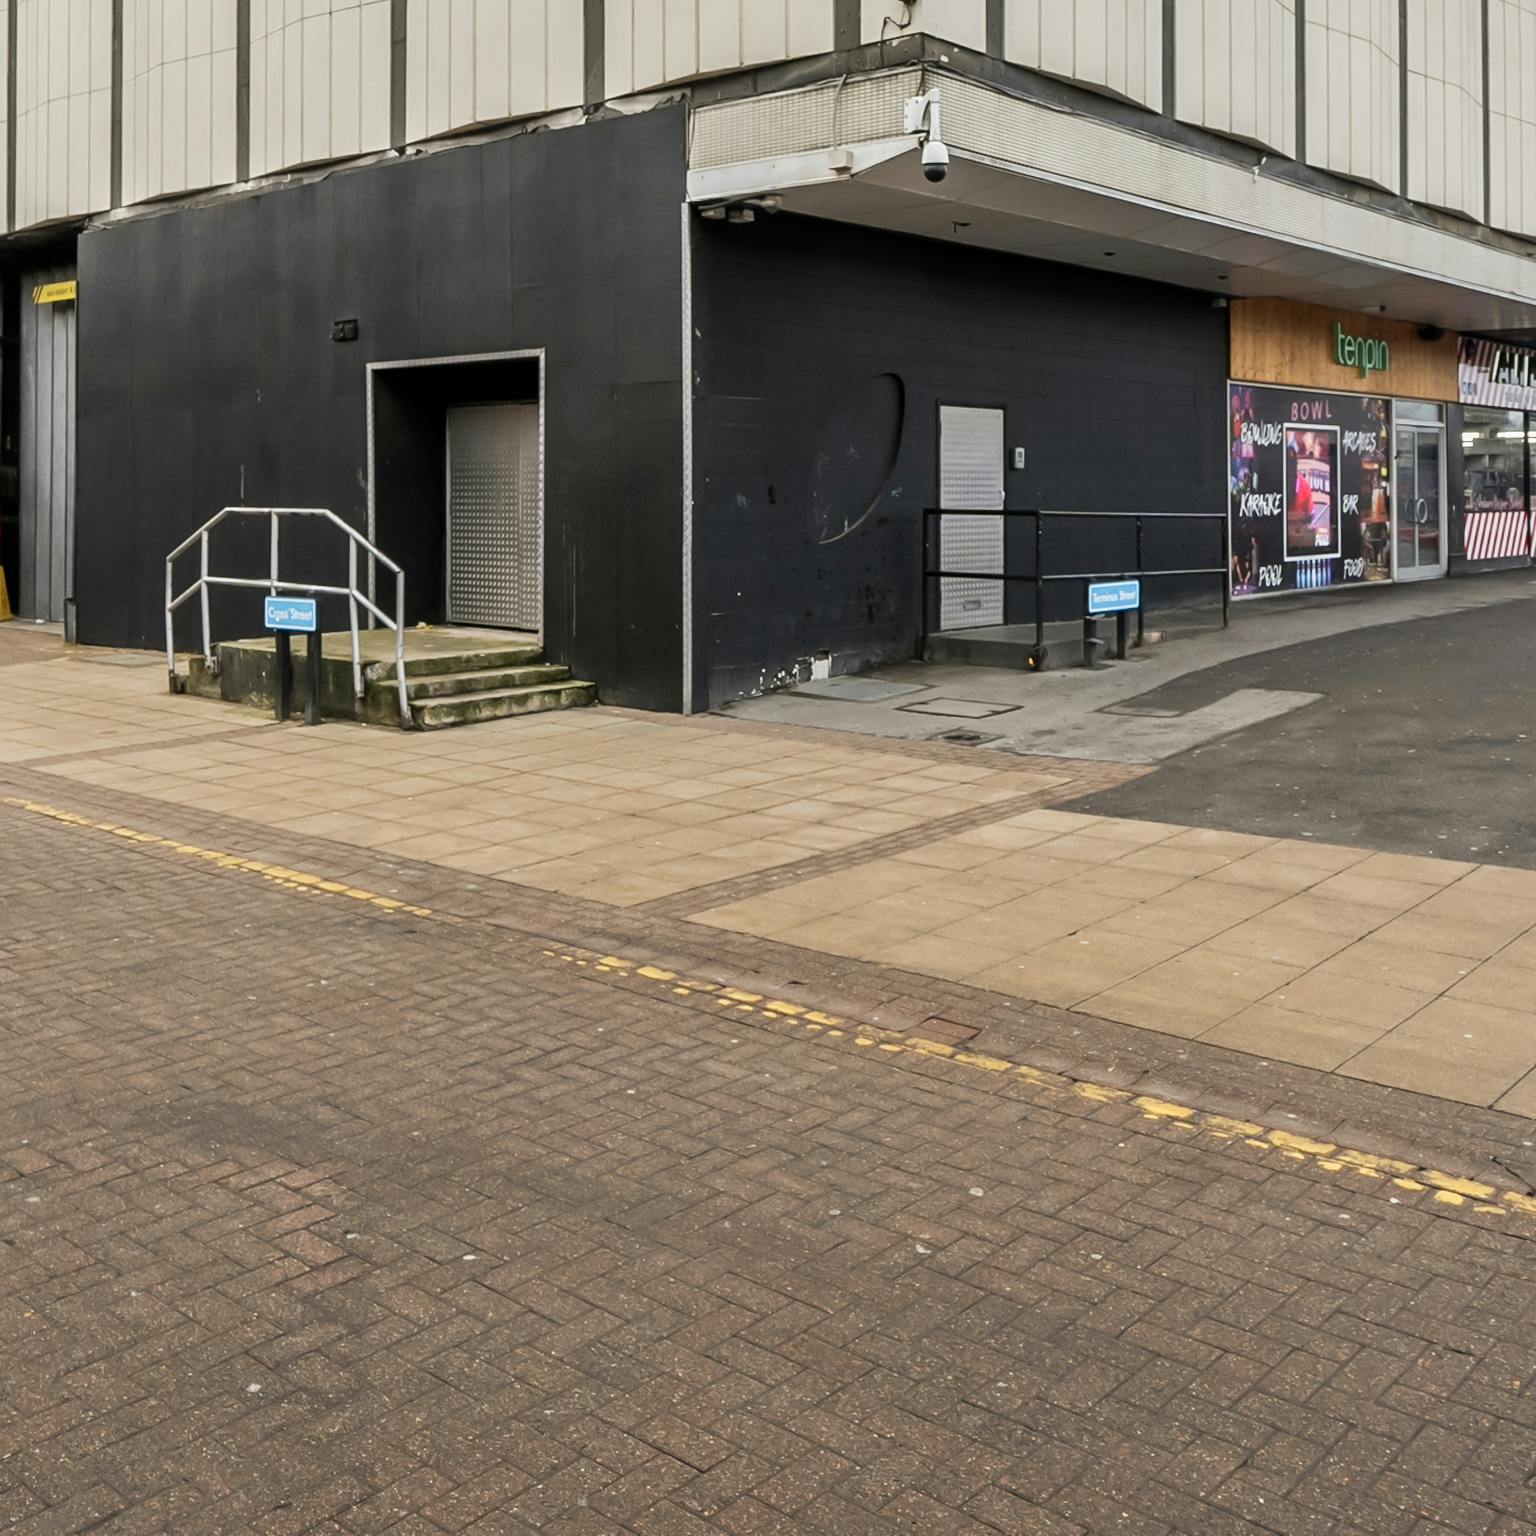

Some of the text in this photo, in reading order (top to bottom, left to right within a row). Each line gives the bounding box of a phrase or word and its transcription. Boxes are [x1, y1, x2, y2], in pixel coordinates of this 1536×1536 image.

[1335, 322, 1390, 379] tenpin
[1291, 399, 1332, 421] BOWL
[1240, 419, 1283, 447] BOWLING
[1239, 491, 1283, 517] KARAOKE
[1342, 494, 1359, 515] BAR
[1258, 564, 1283, 587] POOL
[1343, 556, 1365, 580] FOOD
[1119, 590, 1136, 601] Street
[290, 607, 313, 621] Street
